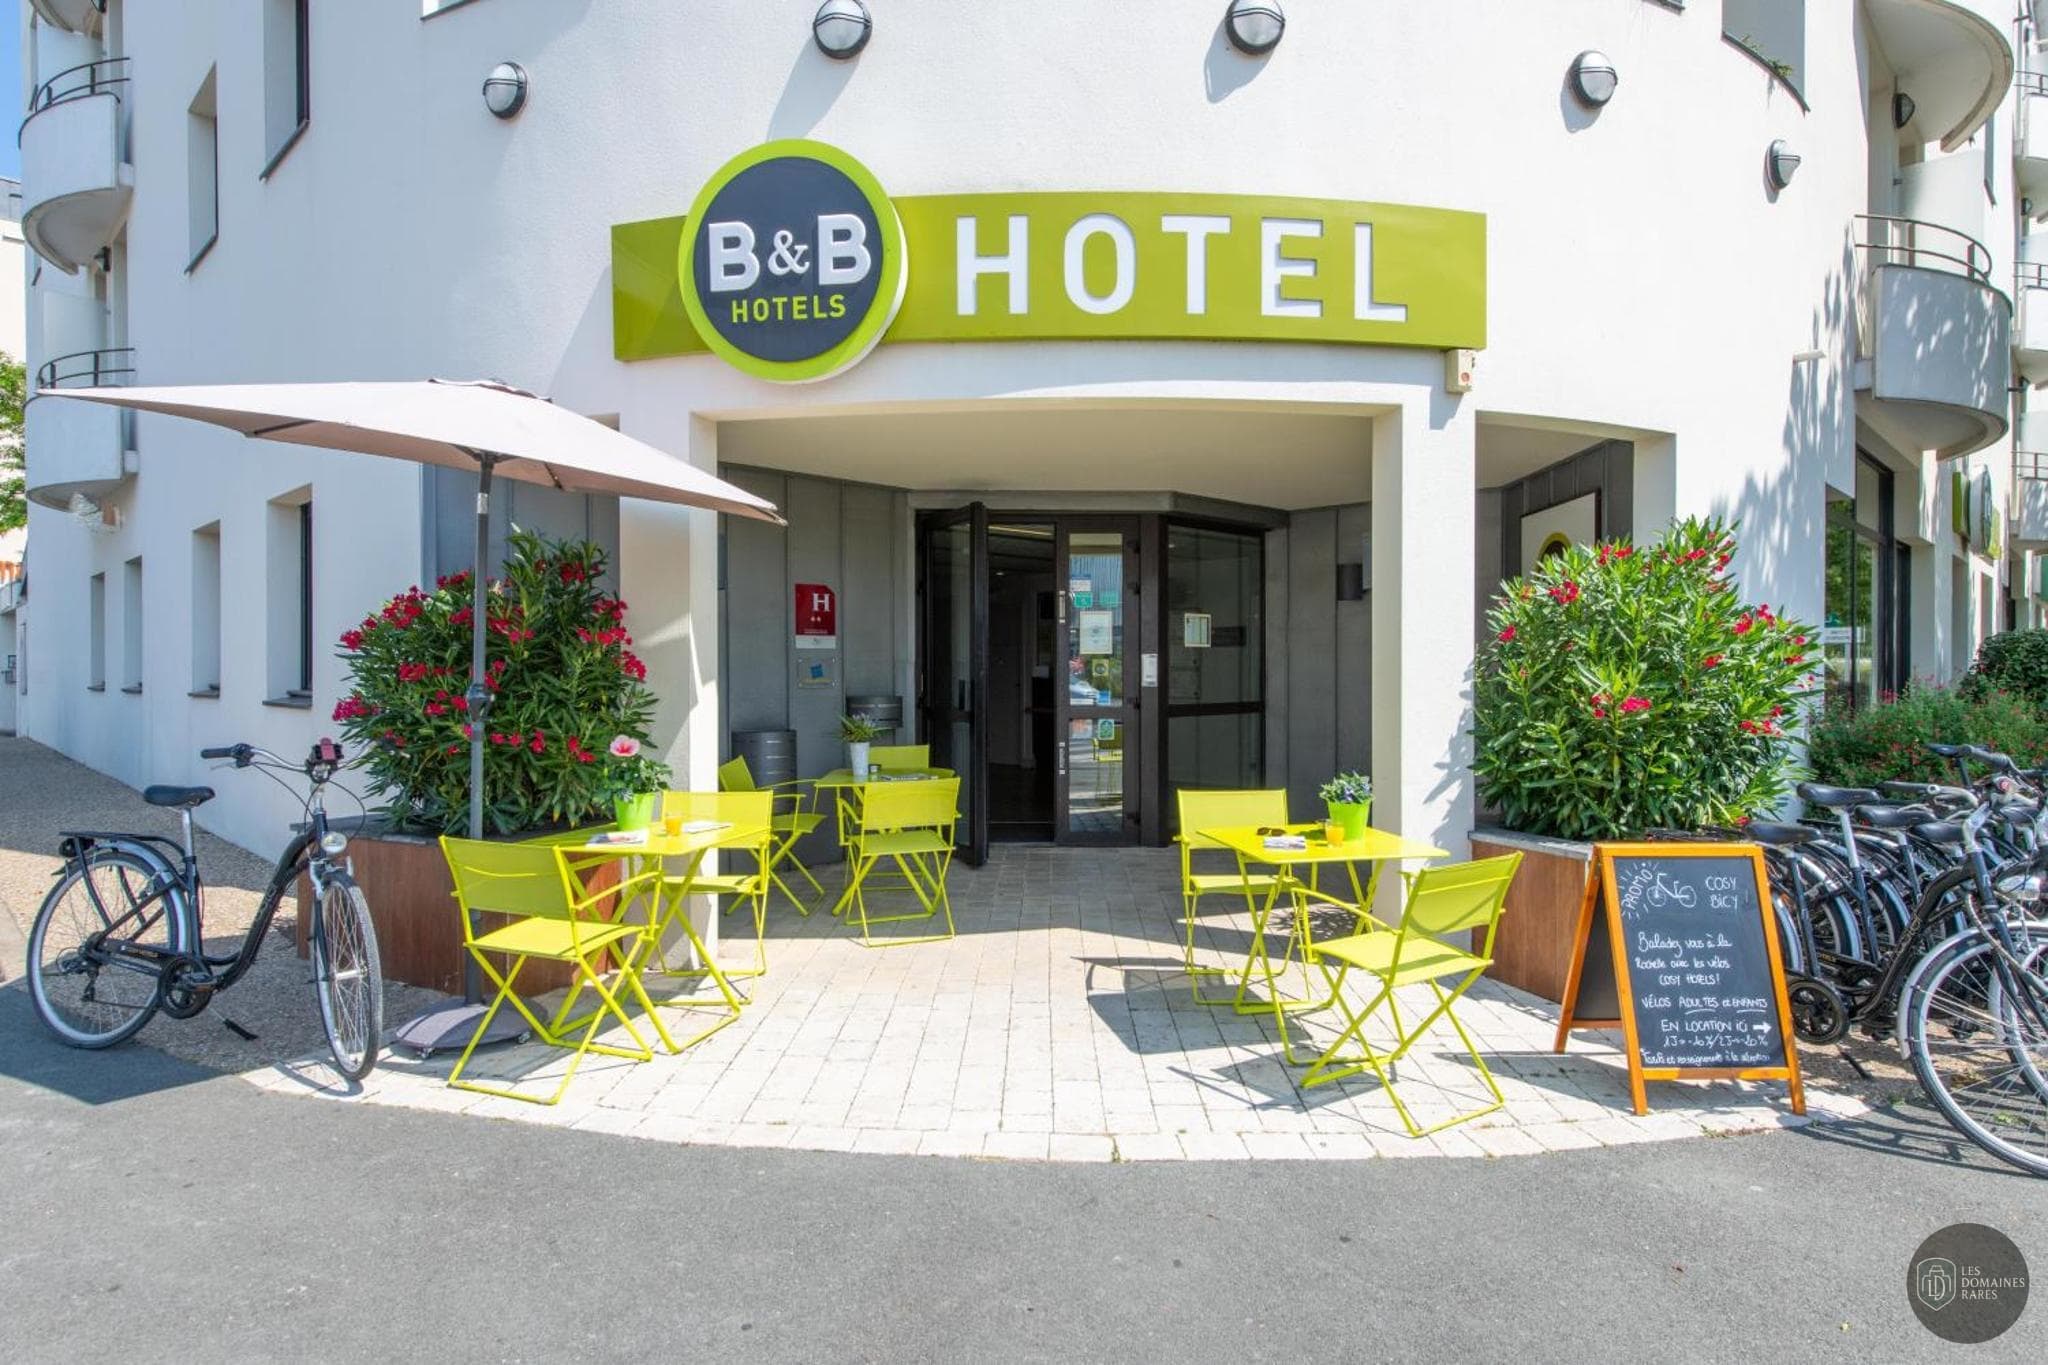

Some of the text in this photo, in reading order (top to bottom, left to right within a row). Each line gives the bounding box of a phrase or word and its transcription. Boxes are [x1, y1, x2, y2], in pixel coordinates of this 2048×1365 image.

[708, 213, 872, 293] B&B
[956, 212, 1408, 323] HOTEL
[731, 294, 847, 323] HOTELS
[813, 593, 830, 612] H
[1621, 868, 1653, 910] PROMO
[1705, 876, 1737, 891] COSY
[1659, 973, 1681, 987] COSY
[1641, 993, 1672, 1009] VÉLOS
[1678, 996, 1719, 1009] ADULTES
[1732, 997, 1769, 1009] ENFANTS
[1661, 1019, 1680, 1033] EN
